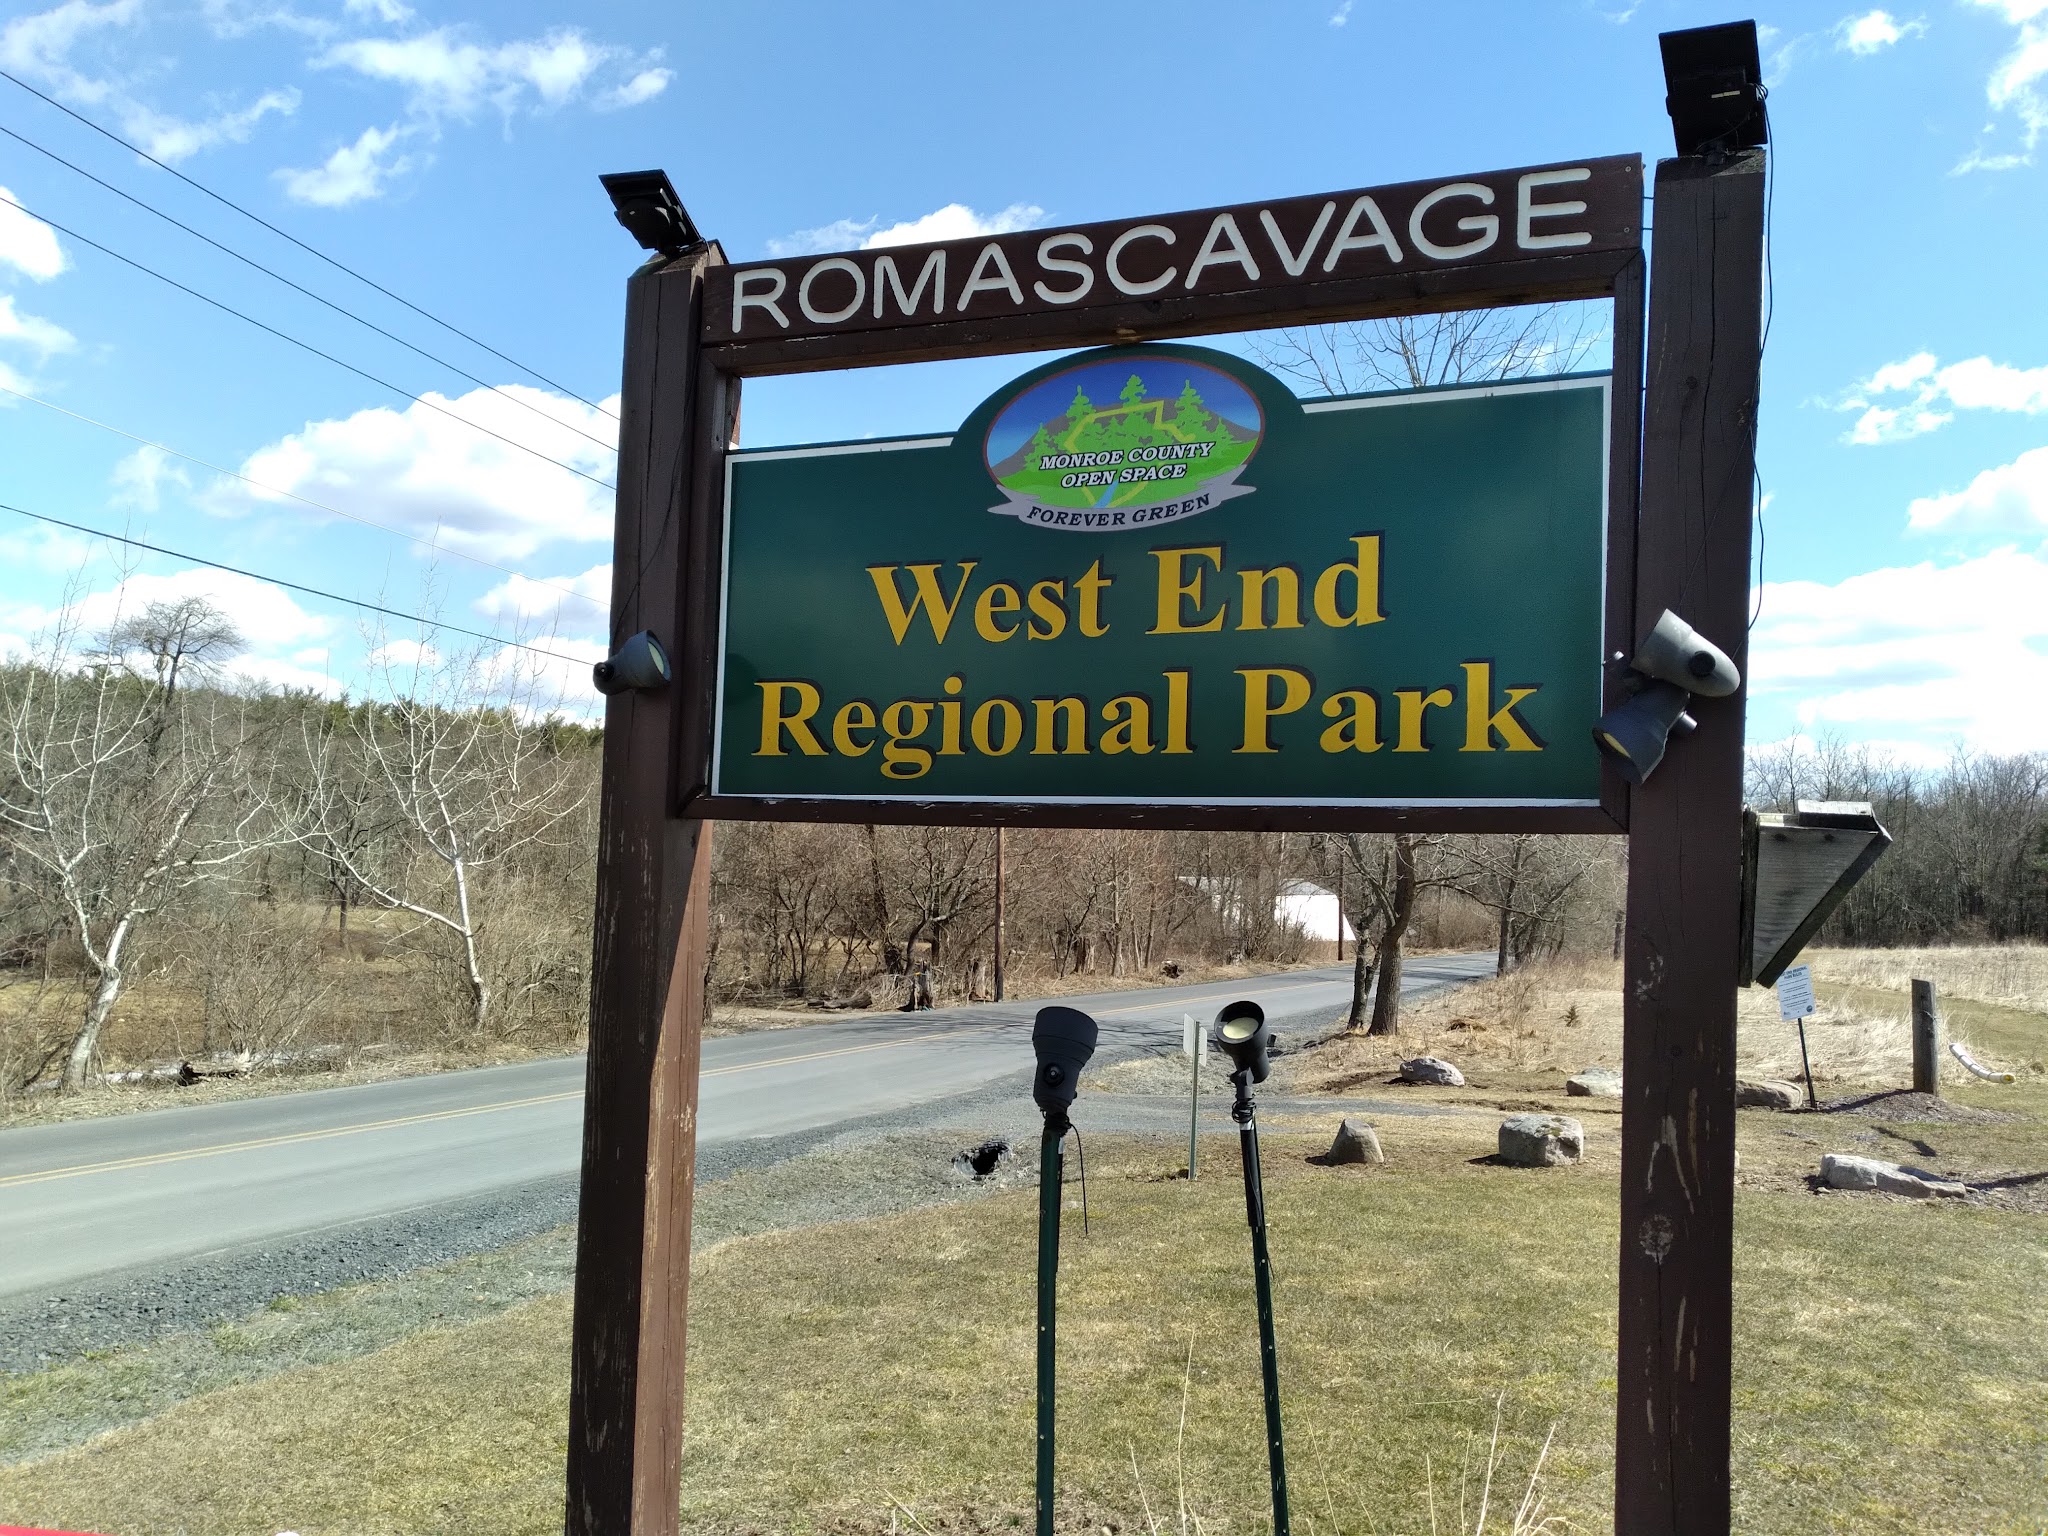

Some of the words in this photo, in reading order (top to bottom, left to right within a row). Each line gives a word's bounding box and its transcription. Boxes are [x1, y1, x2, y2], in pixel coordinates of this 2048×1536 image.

[733, 169, 1592, 333] ROMASCAVAGE
[1040, 449, 1124, 470] MONROE
[1127, 441, 1215, 461] COUNTY
[1061, 470, 1114, 488] OPEN
[1119, 464, 1187, 483] SPACE
[1027, 506, 1126, 527] FOREVER
[1132, 493, 1212, 523] GREEN
[868, 562, 1111, 645] West
[1146, 535, 1386, 635] End
[752, 671, 1193, 780] Regional
[1233, 662, 1542, 753] Park
